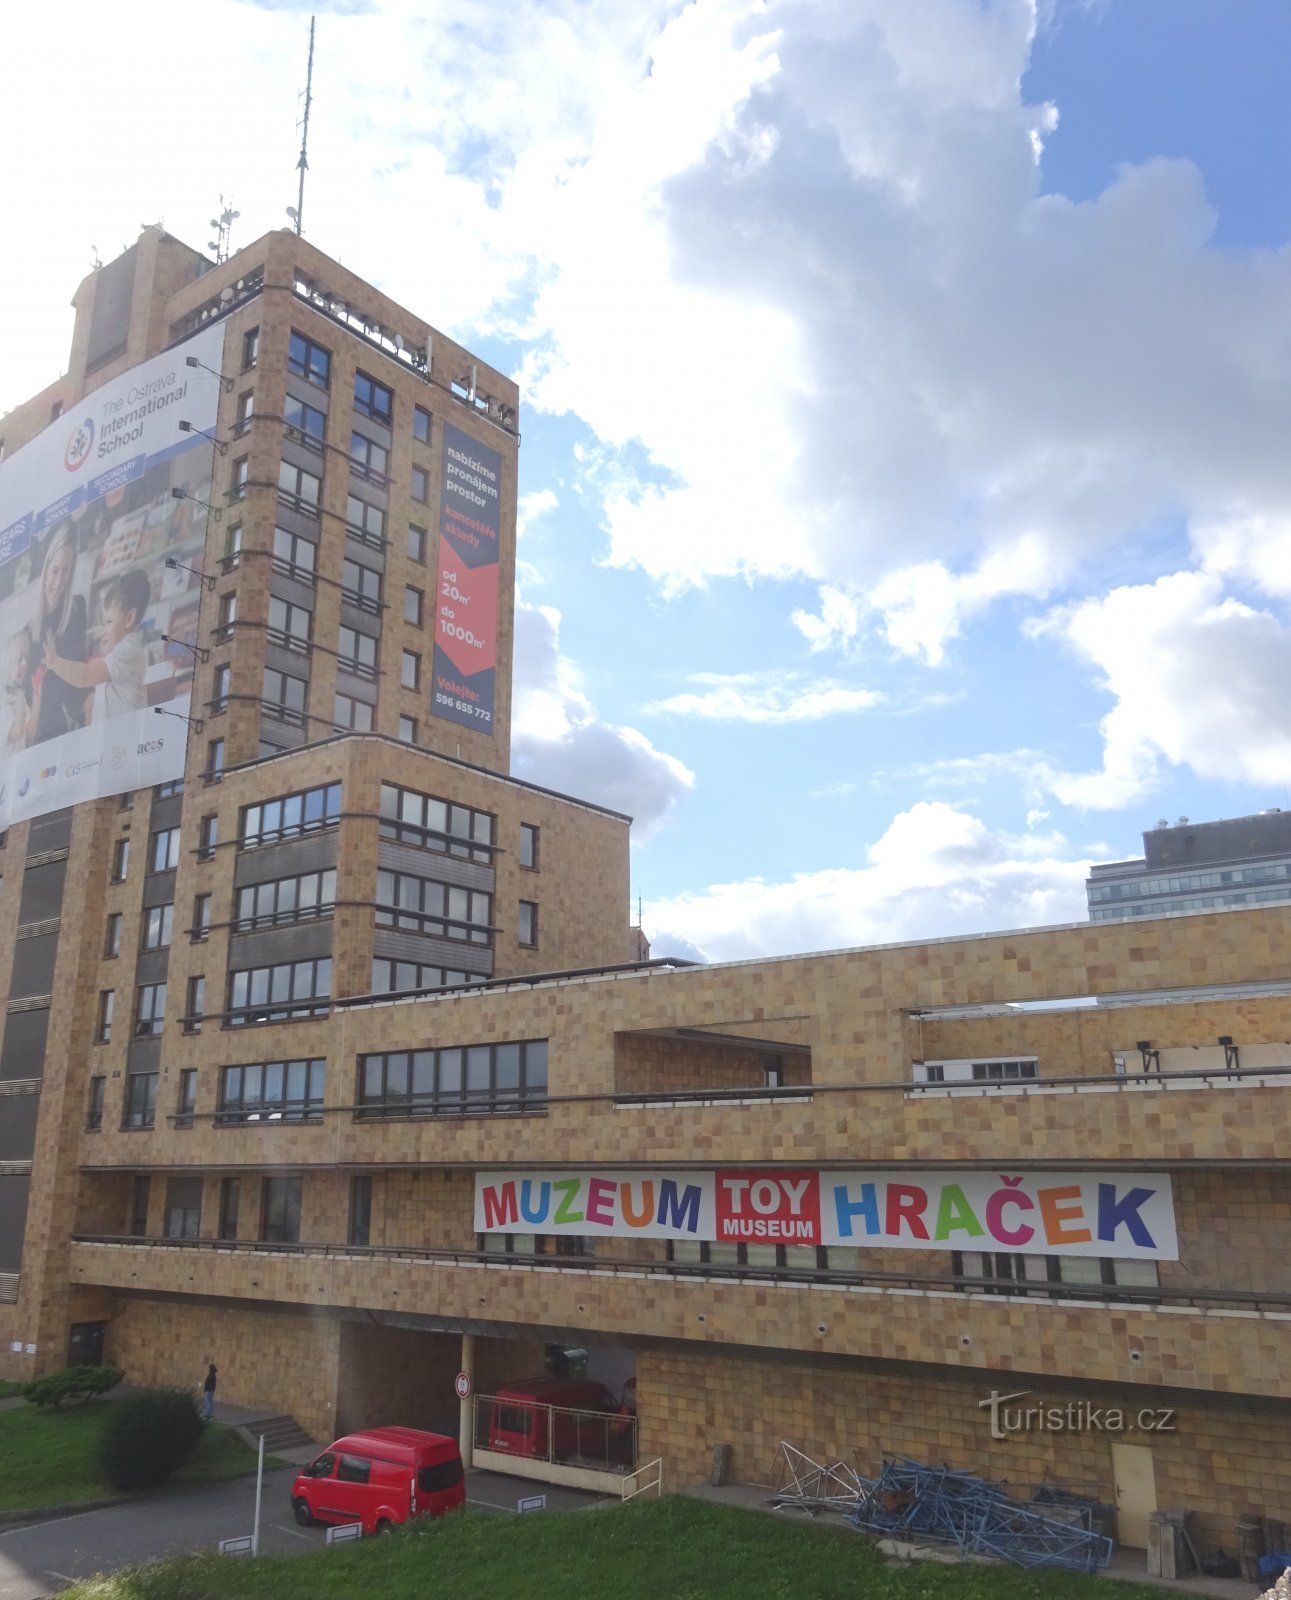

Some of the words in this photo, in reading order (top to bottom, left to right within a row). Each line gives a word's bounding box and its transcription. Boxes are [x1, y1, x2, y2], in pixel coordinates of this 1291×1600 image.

[101, 381, 187, 439] International
[103, 398, 124, 418] The
[127, 372, 176, 405] Ostrava
[98, 421, 144, 458] School
[446, 480, 487, 508] prostor
[445, 522, 480, 550] sklady
[442, 570, 457, 583] od
[441, 605, 455, 619] do
[436, 692, 454, 707] 596
[455, 700, 473, 715] 655
[474, 707, 491, 721] 772
[482, 1177, 702, 1234] MUZEUM
[722, 1179, 809, 1215] TOY
[833, 1175, 1158, 1249] HRAČEK
[723, 1218, 814, 1238] MUSEUM
